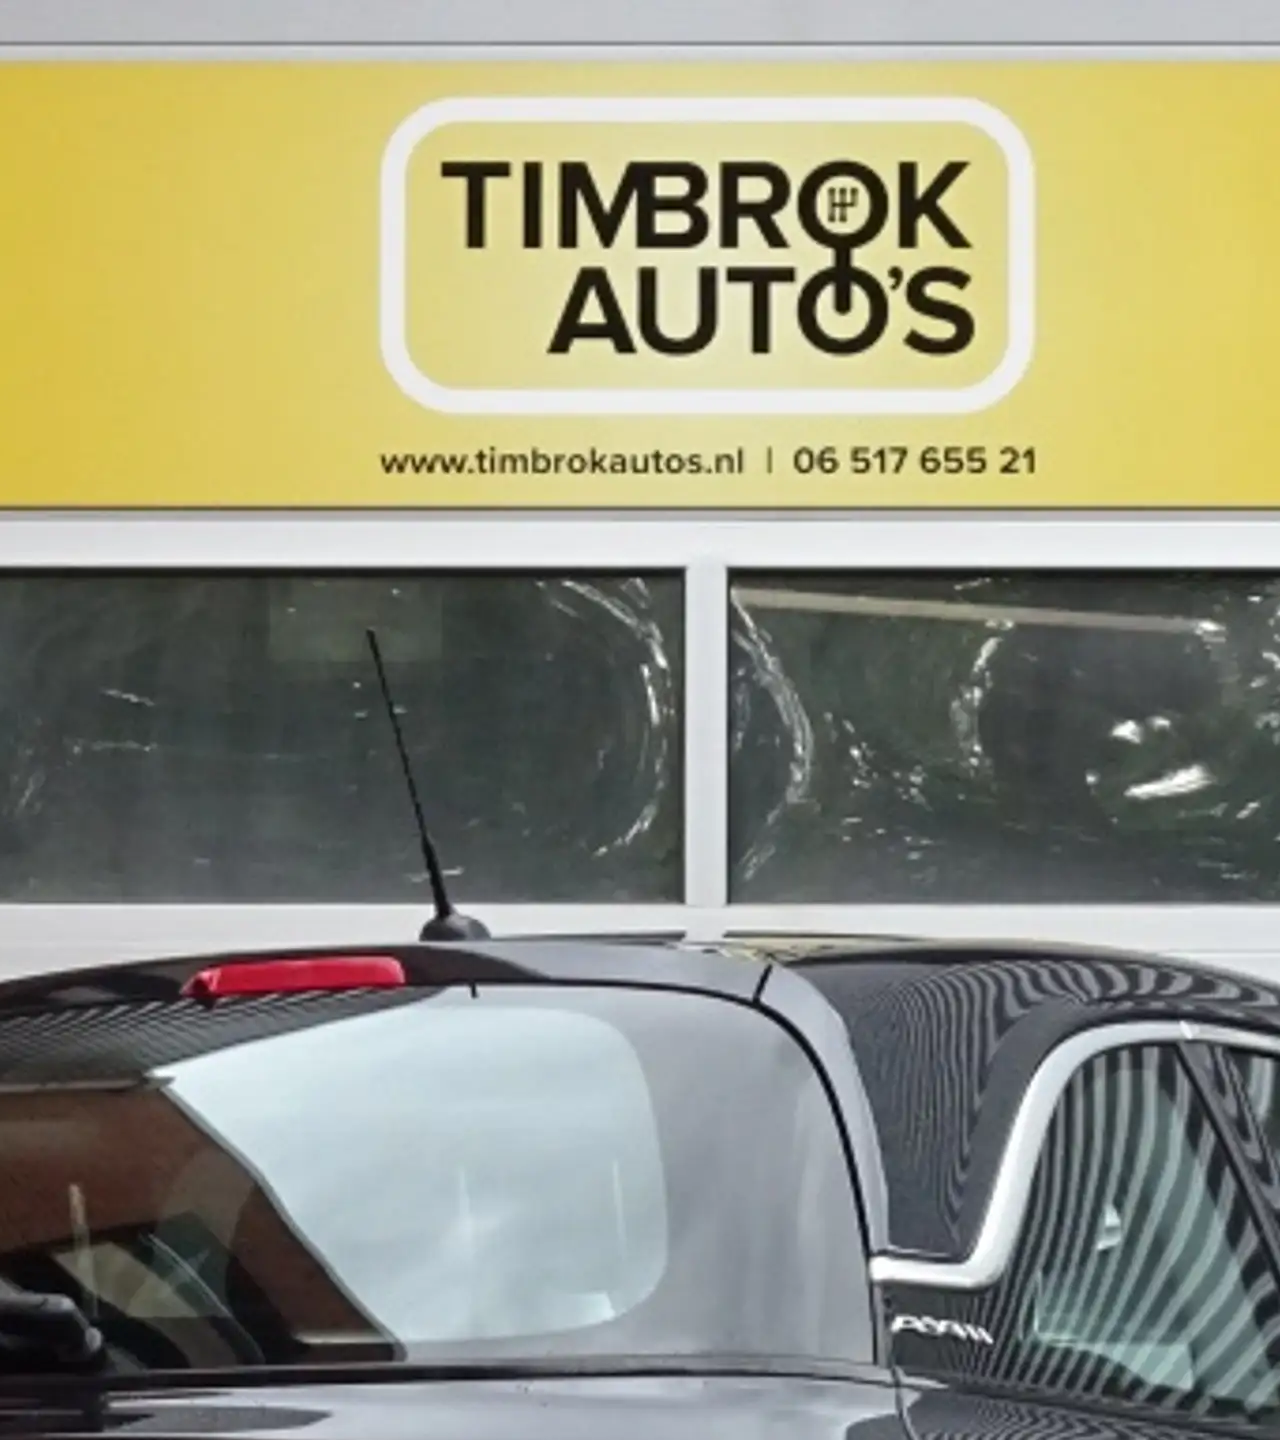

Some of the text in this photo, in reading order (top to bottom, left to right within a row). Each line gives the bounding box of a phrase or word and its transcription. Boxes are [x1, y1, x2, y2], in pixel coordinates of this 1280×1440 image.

[441, 160, 972, 249] TIMBROK
[547, 266, 975, 355] AUTO'S
[380, 447, 1037, 476] www.timbrokautos.nl 06 517 655 21
